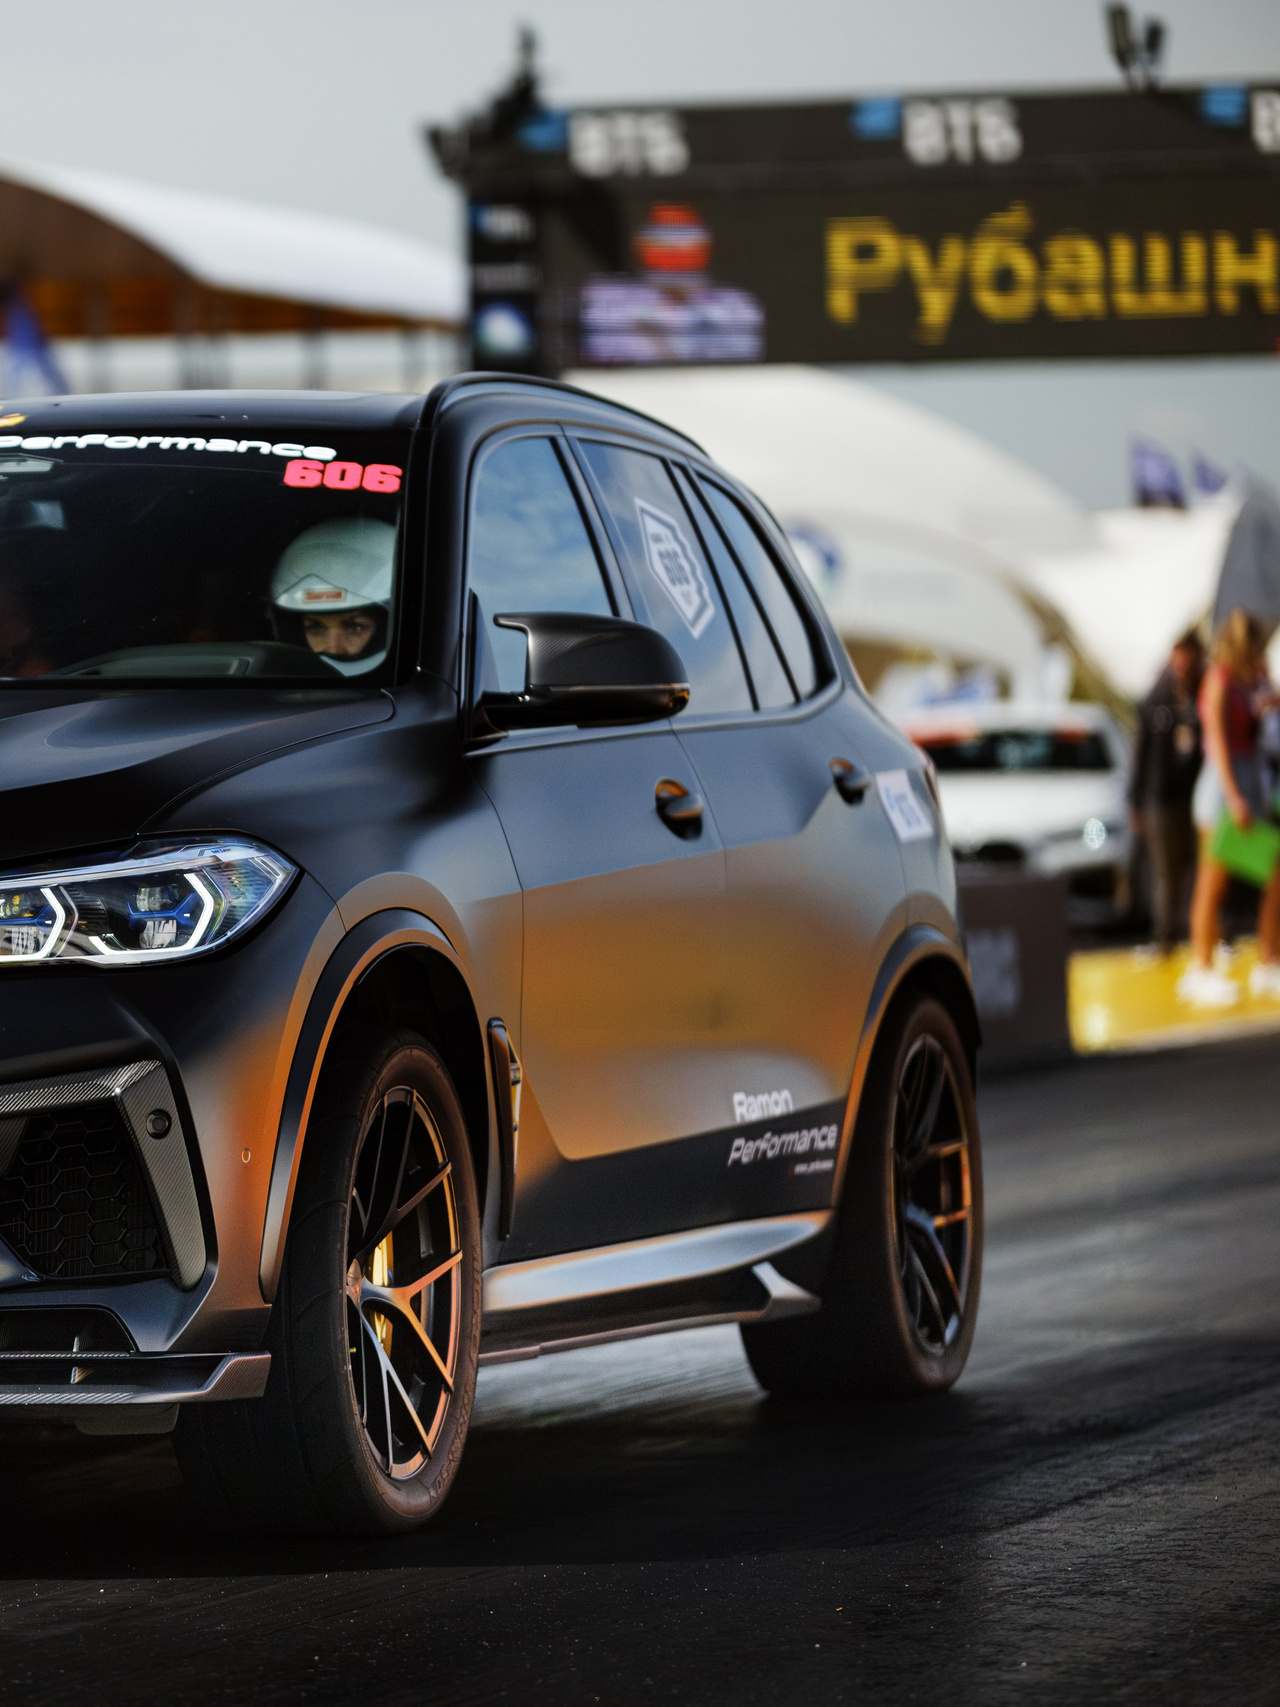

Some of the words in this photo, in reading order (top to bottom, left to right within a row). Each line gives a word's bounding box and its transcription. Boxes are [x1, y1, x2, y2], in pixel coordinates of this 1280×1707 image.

[825, 205, 1279, 344] Рубашн
[283, 459, 403, 494] 606
[732, 1089, 794, 1122] Ramon
[727, 1124, 838, 1167] Performance
